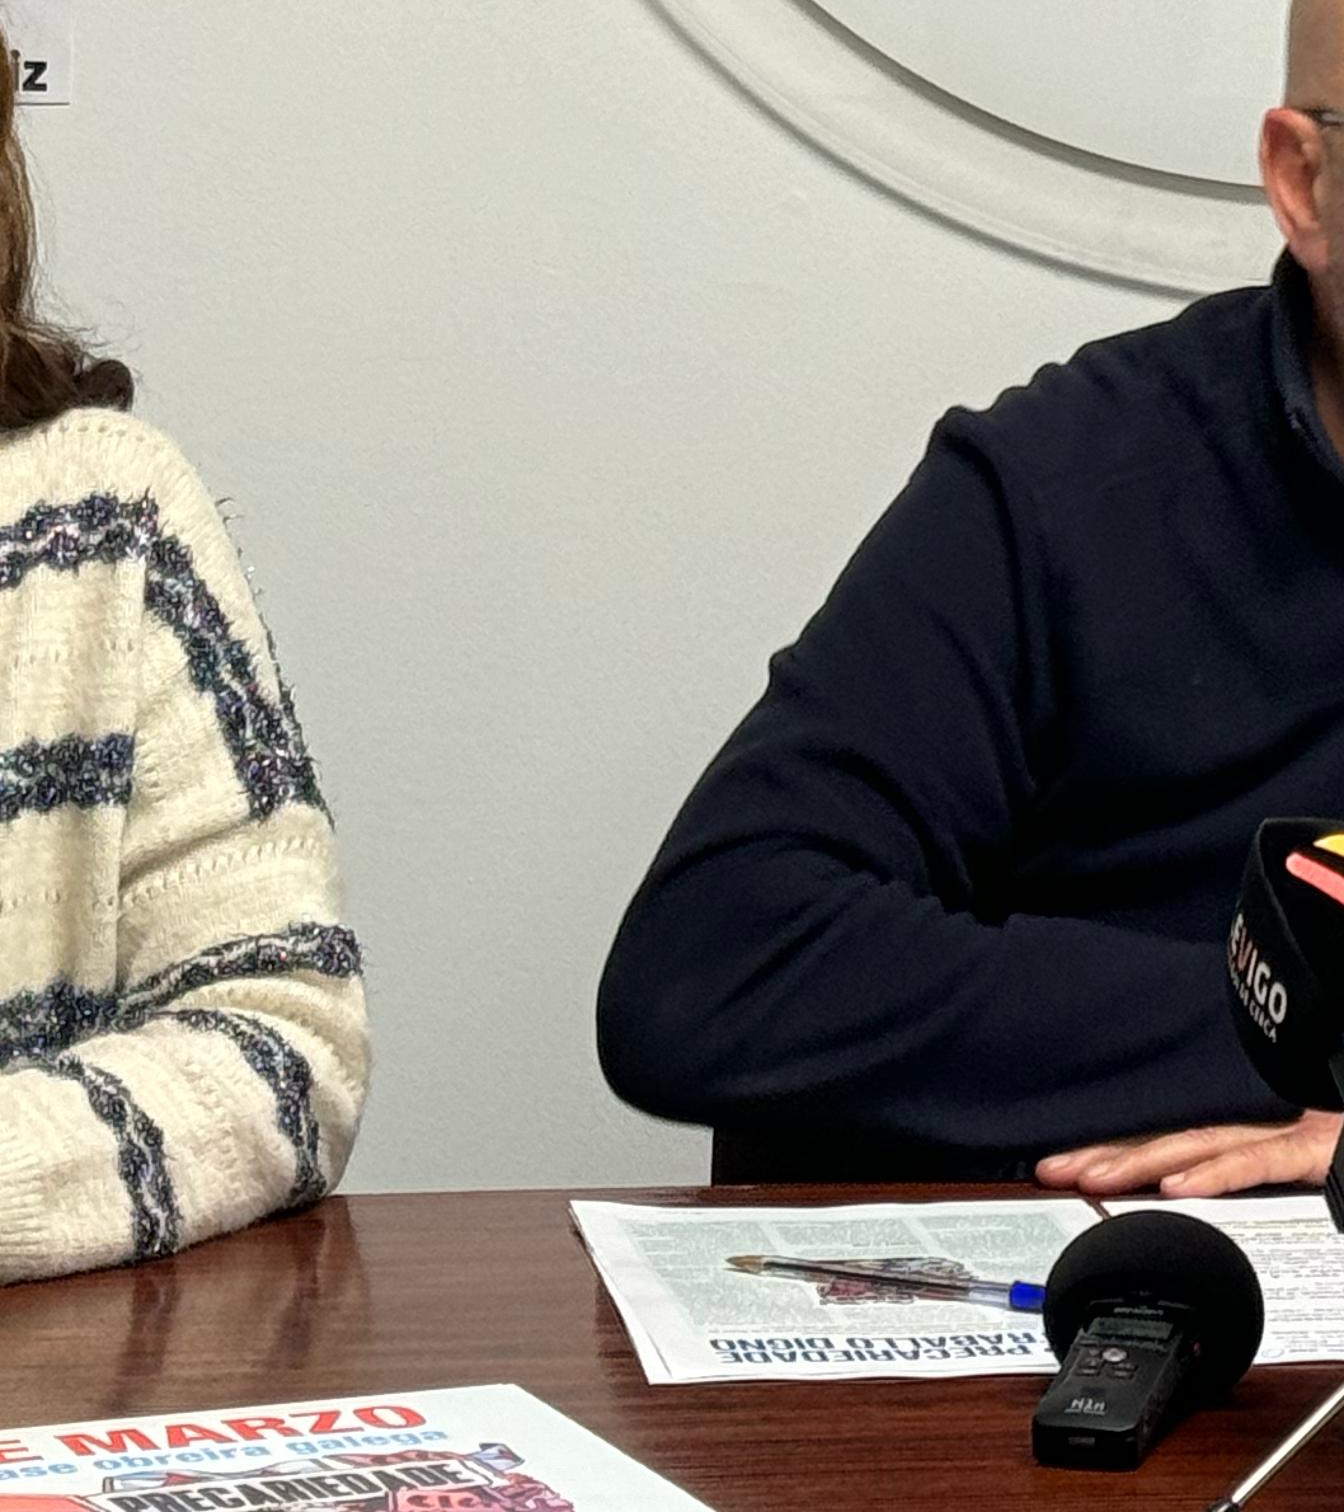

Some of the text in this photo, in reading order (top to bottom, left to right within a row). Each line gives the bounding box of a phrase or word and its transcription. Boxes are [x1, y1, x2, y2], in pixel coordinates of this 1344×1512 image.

[709, 1338, 835, 1351] DIGNO
[720, 1344, 1033, 1364] PRECARIEDADE
[846, 1331, 1040, 1351] RABALLO
[54, 1405, 426, 1456] MARZO
[94, 1441, 270, 1472] obreira
[286, 1428, 449, 1455] galega
[106, 1463, 472, 1512] PRECARIEDADE
